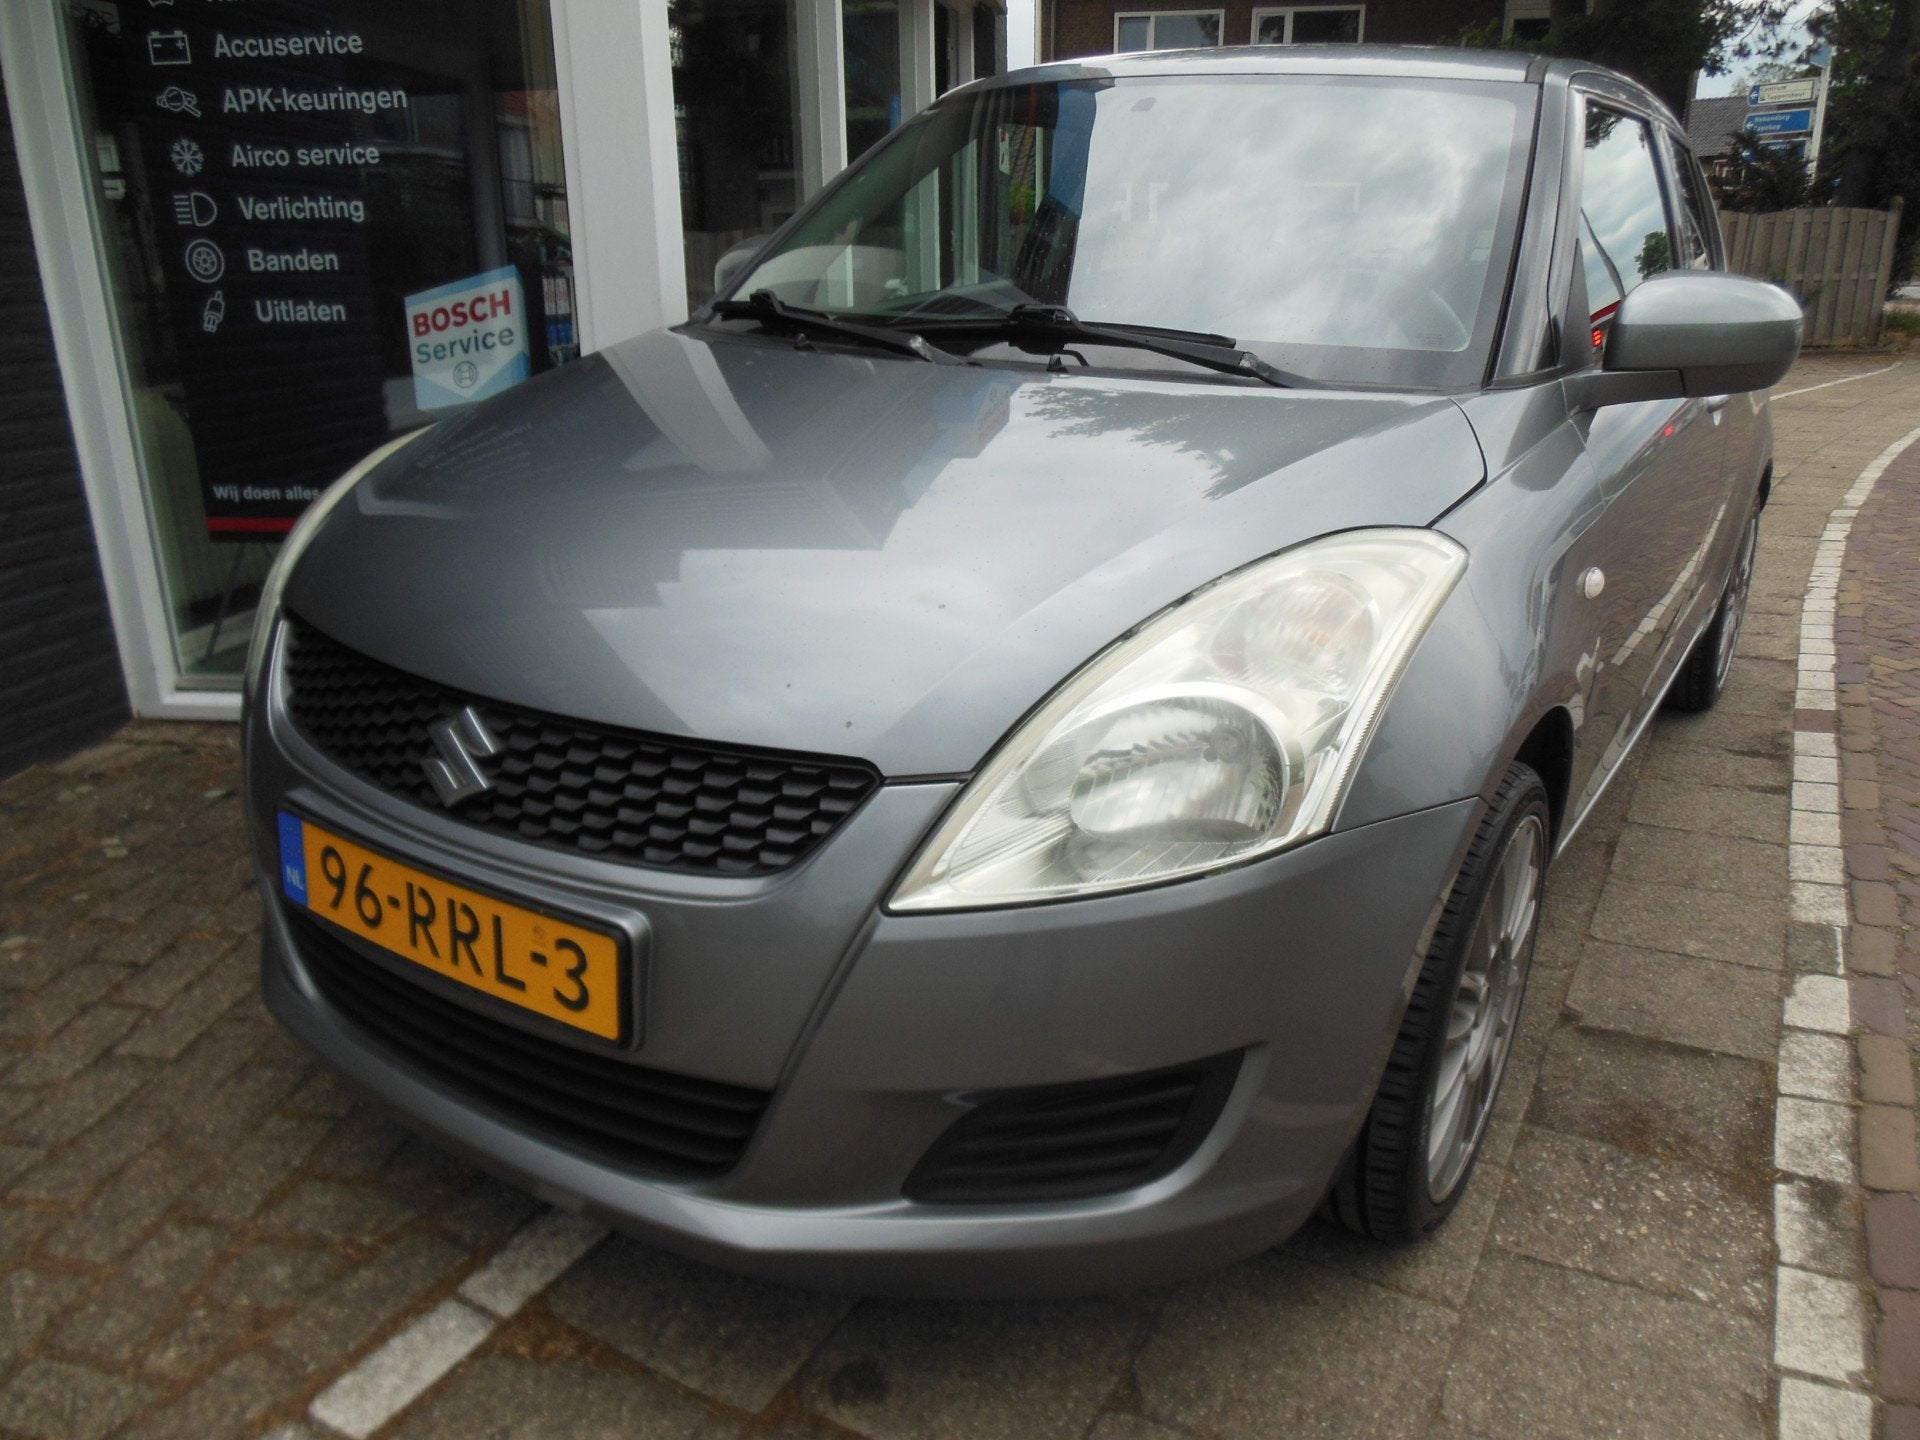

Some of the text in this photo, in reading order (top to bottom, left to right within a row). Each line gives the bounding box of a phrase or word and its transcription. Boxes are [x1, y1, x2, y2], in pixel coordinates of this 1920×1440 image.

[214, 30, 363, 58] Accuservice
[223, 87, 407, 114] APK-keuringen
[232, 143, 380, 167] Airco service
[238, 196, 365, 223] Verlichting
[248, 249, 339, 272] Banden
[255, 299, 346, 322] Uitlaten
[412, 289, 511, 338] BOSCH
[416, 328, 514, 364] Service
[213, 485, 319, 502] Wij doen alles
[286, 866, 304, 890] NL
[320, 844, 590, 1012] 96-RRL-3
